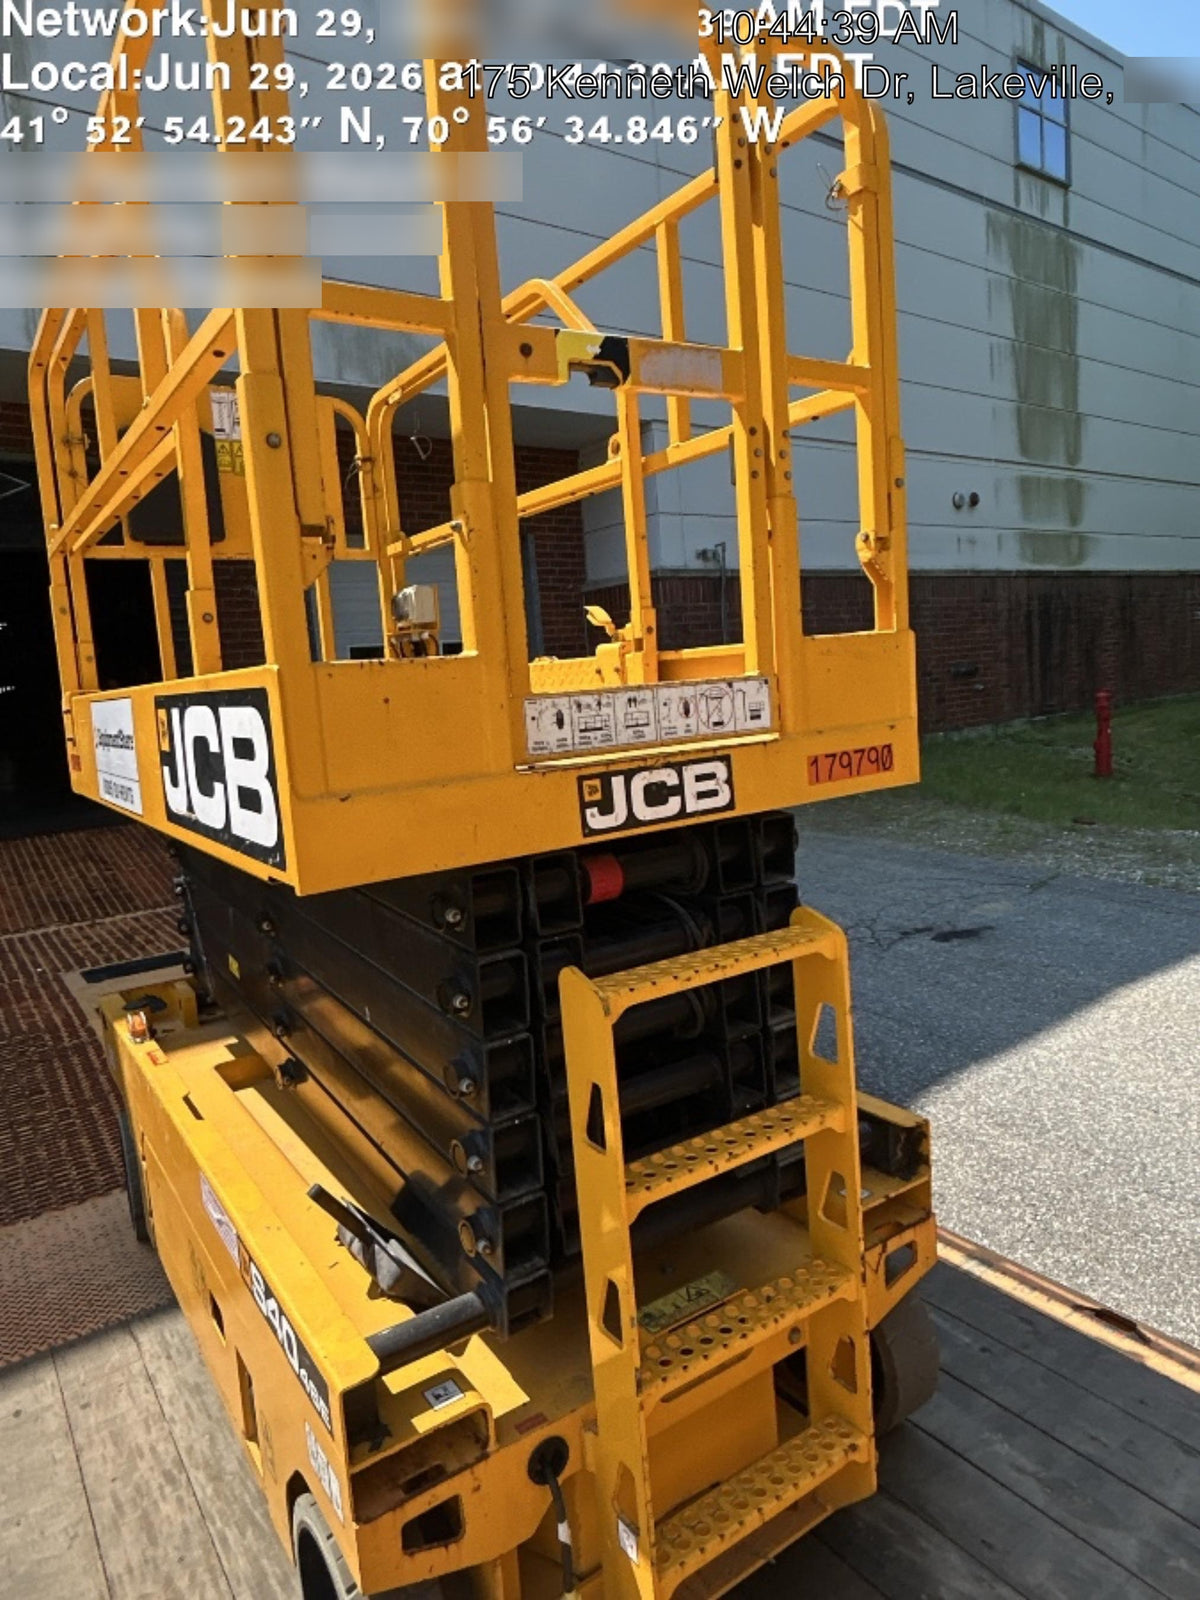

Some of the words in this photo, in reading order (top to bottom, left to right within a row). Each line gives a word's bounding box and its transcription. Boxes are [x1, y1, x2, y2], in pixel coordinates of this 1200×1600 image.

[163, 704, 279, 848] JCB
[584, 760, 732, 830] JCB
[810, 743, 894, 784] 179790
